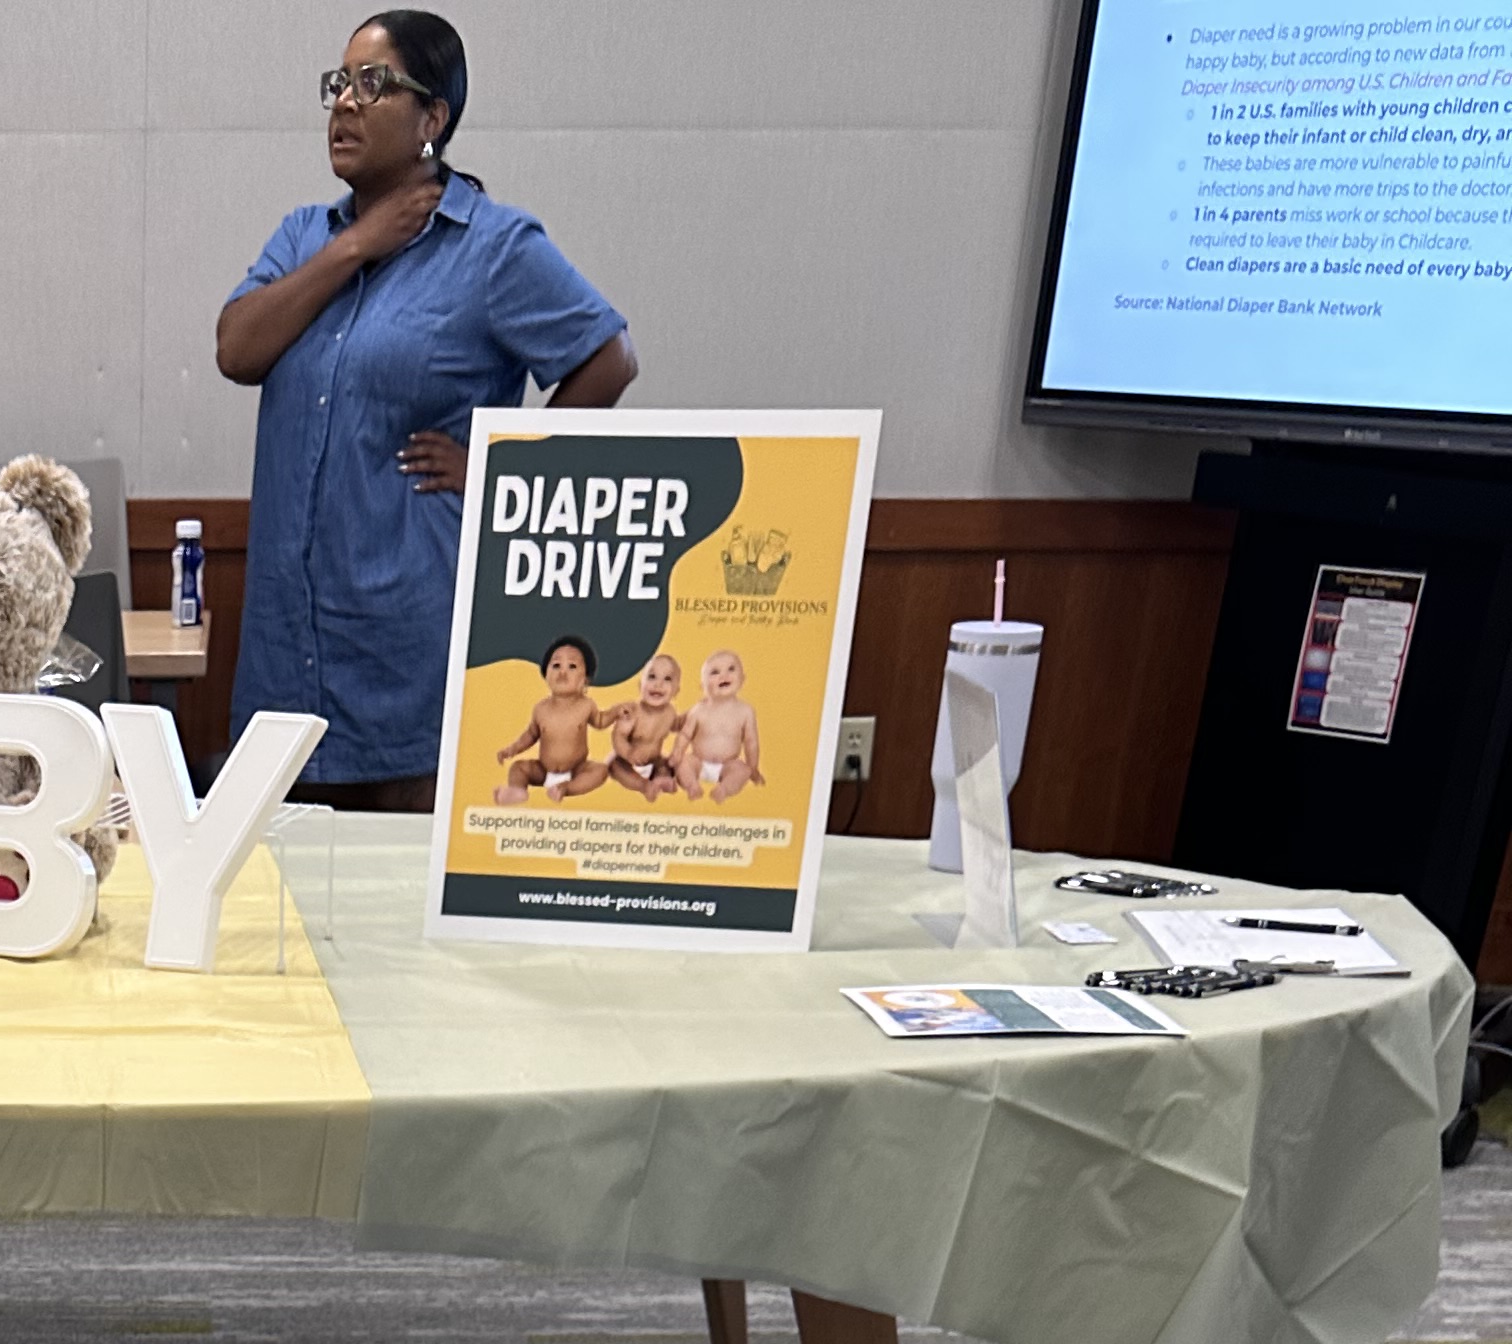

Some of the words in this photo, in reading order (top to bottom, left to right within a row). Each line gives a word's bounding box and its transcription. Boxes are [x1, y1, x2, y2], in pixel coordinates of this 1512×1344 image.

[1190, 28, 1235, 44] Diaper
[1238, 24, 1275, 41] need
[1278, 23, 1288, 40] is
[1291, 26, 1300, 39] a
[1304, 21, 1364, 42] growing
[1368, 16, 1432, 39] problem
[1436, 16, 1450, 32] in
[1454, 16, 1480, 32] our
[1212, 105, 1216, 120] 1
[1221, 104, 1233, 119] in
[1237, 105, 1246, 118] 2
[1250, 104, 1276, 118] U.S.
[1280, 101, 1338, 118] families
[1343, 98, 1376, 116] with
[1379, 103, 1429, 119] young
[1434, 97, 1499, 114] children
[1208, 132, 1221, 145] to
[1226, 130, 1260, 148] keep
[1264, 128, 1299, 144] their
[1301, 127, 1346, 144] infant
[1350, 130, 1366, 143] or
[1370, 126, 1408, 142] child
[1412, 126, 1457, 144] clean,
[1462, 126, 1491, 145] dry,
[1194, 207, 1200, 221] 1
[1203, 206, 1216, 221] in
[1220, 207, 1229, 221] 4
[1232, 208, 1287, 224] parents
[1290, 206, 1323, 222] miss
[1326, 208, 1361, 223] work
[1364, 211, 1379, 222] or
[1383, 208, 1432, 223] school
[1435, 208, 1498, 223] because
[1114, 295, 1164, 310] Source:
[1166, 297, 1224, 311] National
[1228, 298, 1274, 316] Diaper
[1278, 298, 1314, 314] Bank
[1318, 300, 1382, 316] Network
[491, 475, 688, 537] DIAPER
[504, 539, 664, 599] DRIVE
[675, 598, 737, 612] BLESSED
[741, 601, 827, 613] PROVISIONS
[469, 815, 544, 832] Supporting
[548, 817, 582, 831] local
[585, 820, 639, 833] families
[643, 821, 687, 837] facing
[691, 823, 768, 841] challenges
[773, 826, 785, 839] in
[501, 836, 566, 854] providing
[570, 839, 621, 856] diapers
[626, 841, 645, 854] for
[648, 842, 679, 855] their
[683, 843, 743, 858] children.
[583, 860, 660, 873] #diaperneed
[519, 890, 716, 916] www.blessed-provisions.org
